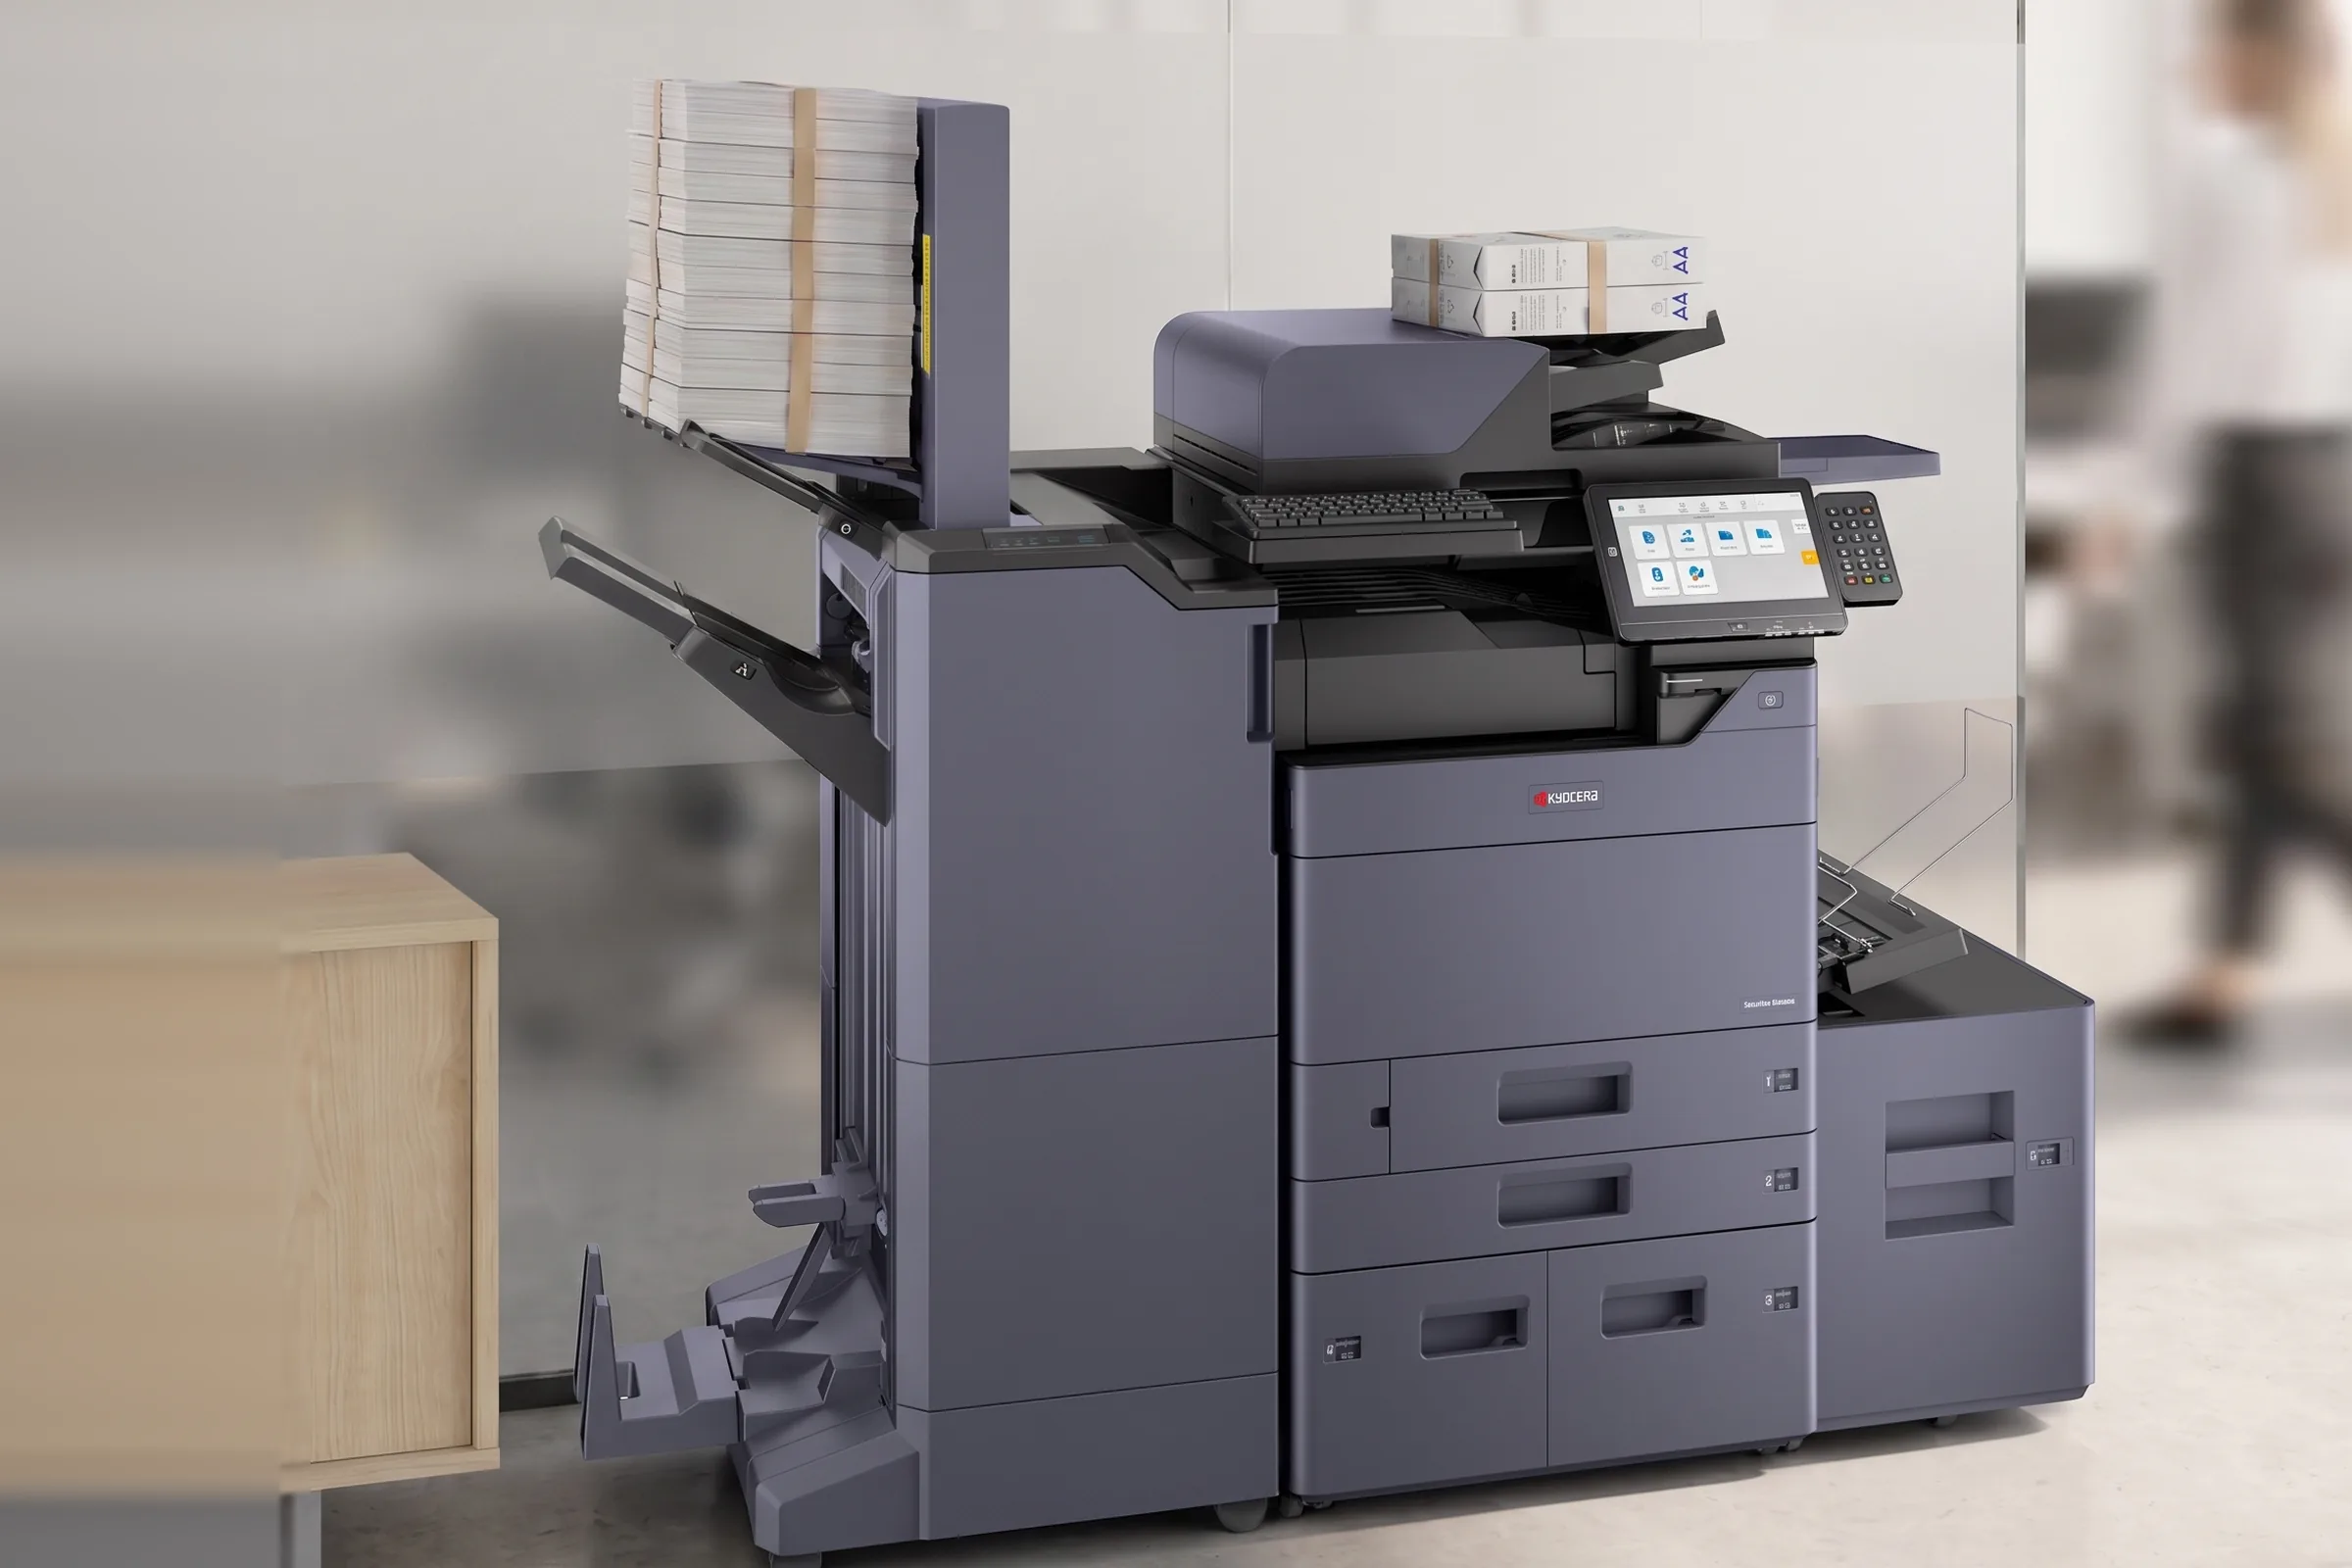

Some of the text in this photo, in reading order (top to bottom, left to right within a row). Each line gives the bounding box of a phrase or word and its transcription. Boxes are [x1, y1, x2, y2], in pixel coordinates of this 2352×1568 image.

[1672, 246, 1689, 274] AA
[1672, 292, 1689, 321] AA
[1547, 790, 1598, 805] KYOCERA
[1765, 1174, 1772, 1187] 2
